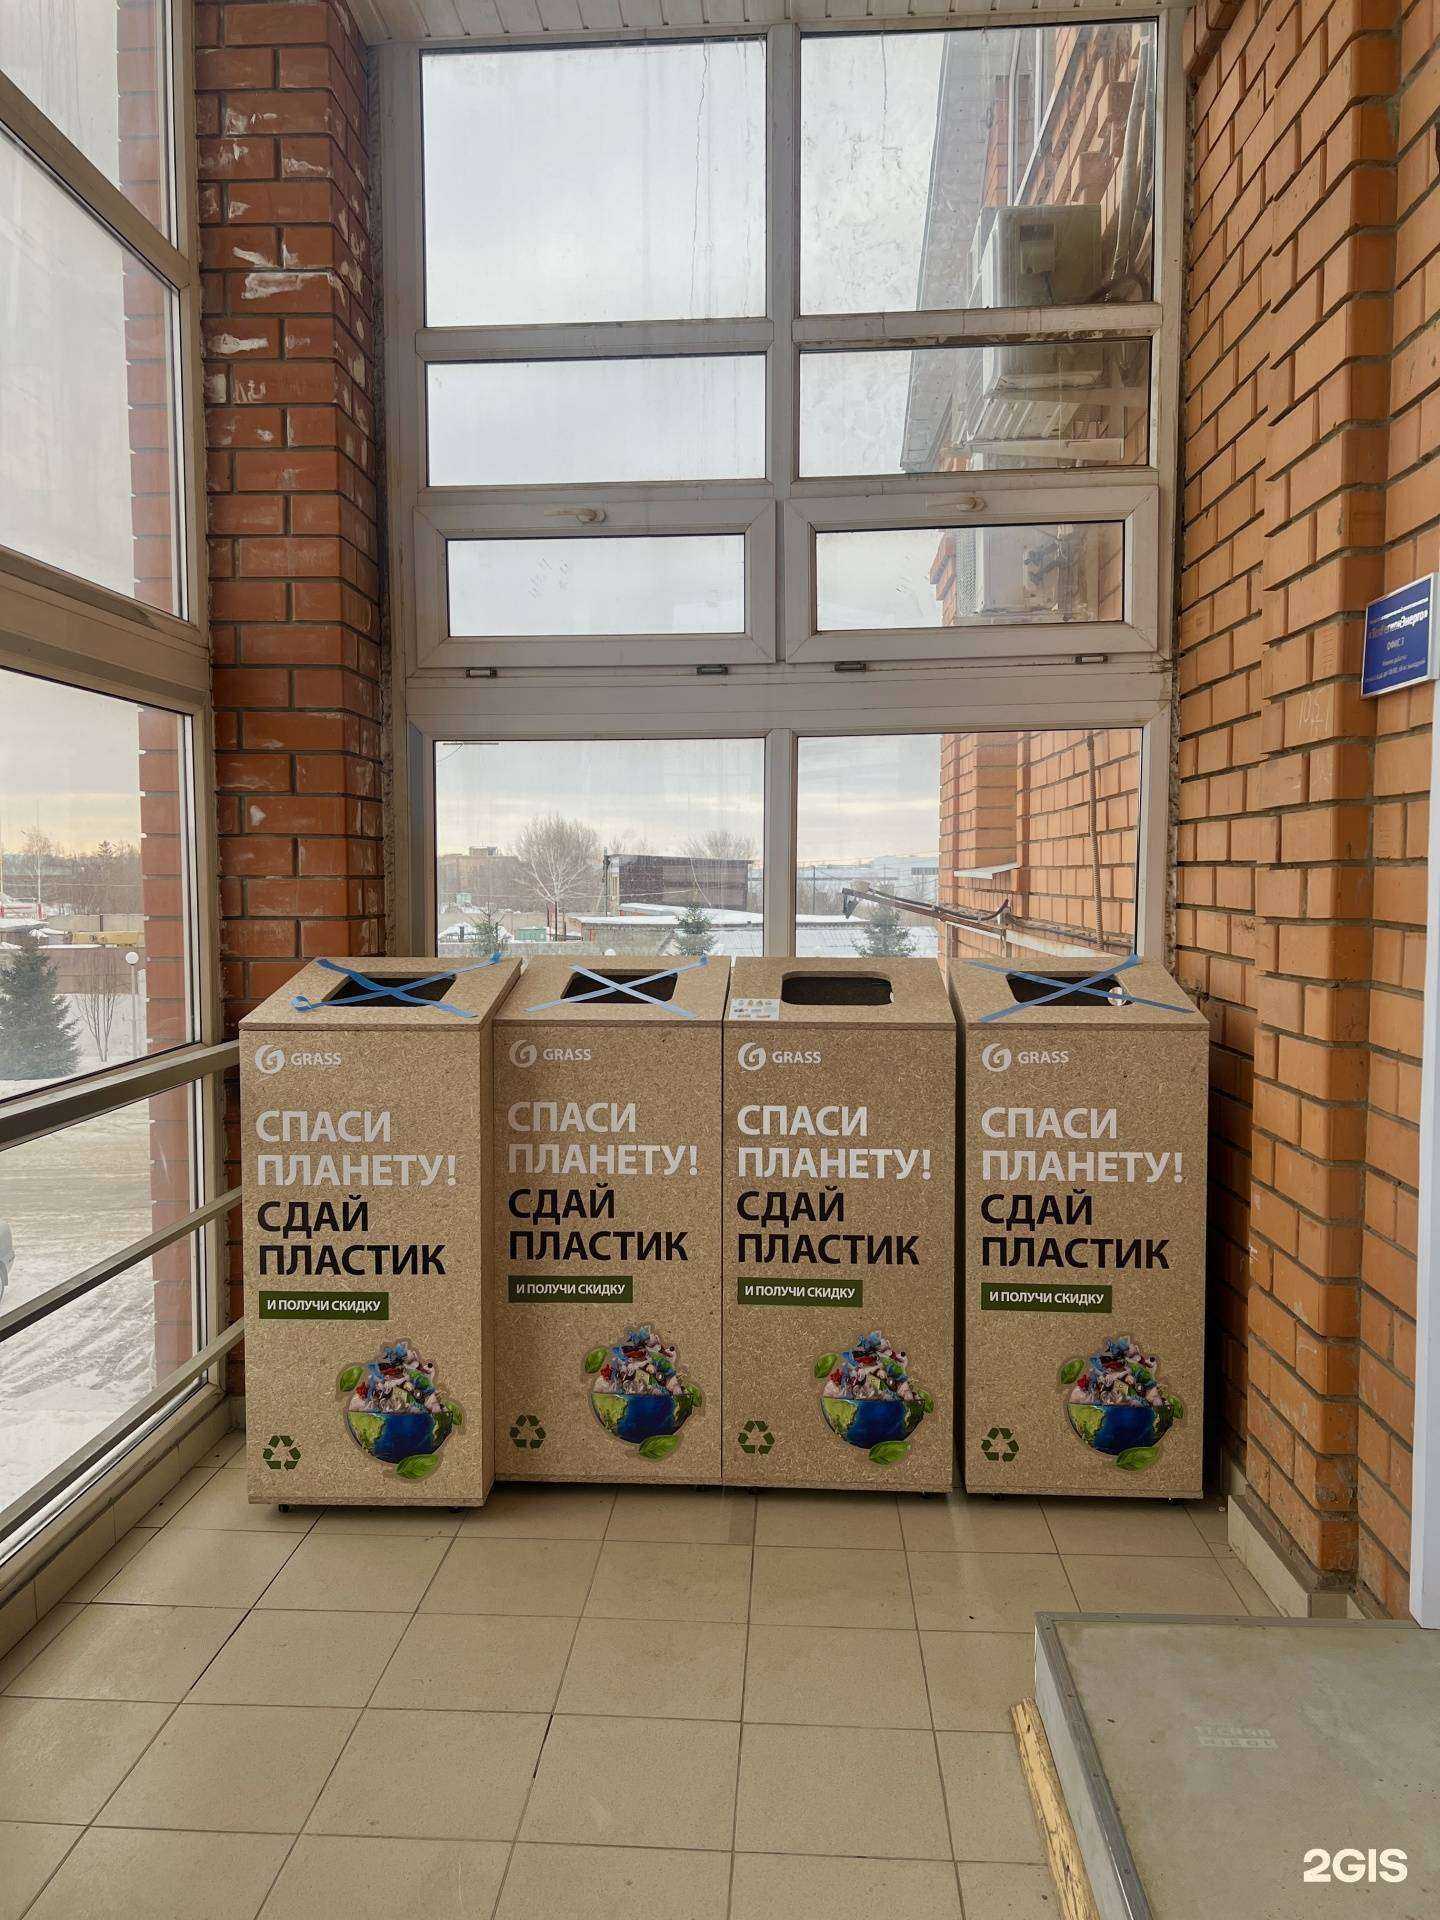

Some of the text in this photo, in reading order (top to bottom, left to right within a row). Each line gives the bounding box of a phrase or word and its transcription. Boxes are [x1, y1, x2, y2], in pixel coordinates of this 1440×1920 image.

[291, 1053, 342, 1066] GRASS
[543, 1048, 592, 1061] GRASS
[772, 1051, 822, 1064] GRASS
[1018, 1051, 1070, 1064] GRASS
[255, 1110, 391, 1143] СПАСИ
[507, 1102, 636, 1133] СПАСИ
[737, 1105, 868, 1136] СПАСИ
[981, 1107, 1117, 1139] СПАСИ
[257, 1154, 456, 1186] ПЛАНЕТУ!
[508, 1143, 698, 1176] ПЛАНЕТУ!
[738, 1147, 931, 1181] ПЛАНЕТУ!
[982, 1150, 1183, 1183] ПЛАНЕТУ!
[257, 1194, 369, 1239] СДАЙ
[508, 1182, 615, 1225] СДАЙ
[737, 1185, 844, 1228] СДАЙ
[981, 1188, 1092, 1231] СДАЙ
[259, 1244, 446, 1276] ПЛАСТИК
[509, 1230, 689, 1261] ПЛАСТИК
[738, 1234, 920, 1265] ПЛАСТИК
[982, 1237, 1170, 1269] ПЛАСТИК
[516, 1283, 626, 1296] И ПОЛУЧИ СКИДКУ
[745, 1285, 856, 1300] И ПОЛУЧИ СКИДКУ
[989, 1291, 1104, 1306] И ПОЛУЧИ СКИДКУ
[267, 1299, 381, 1313] И ПОЛУЧИ СКИДКУ
